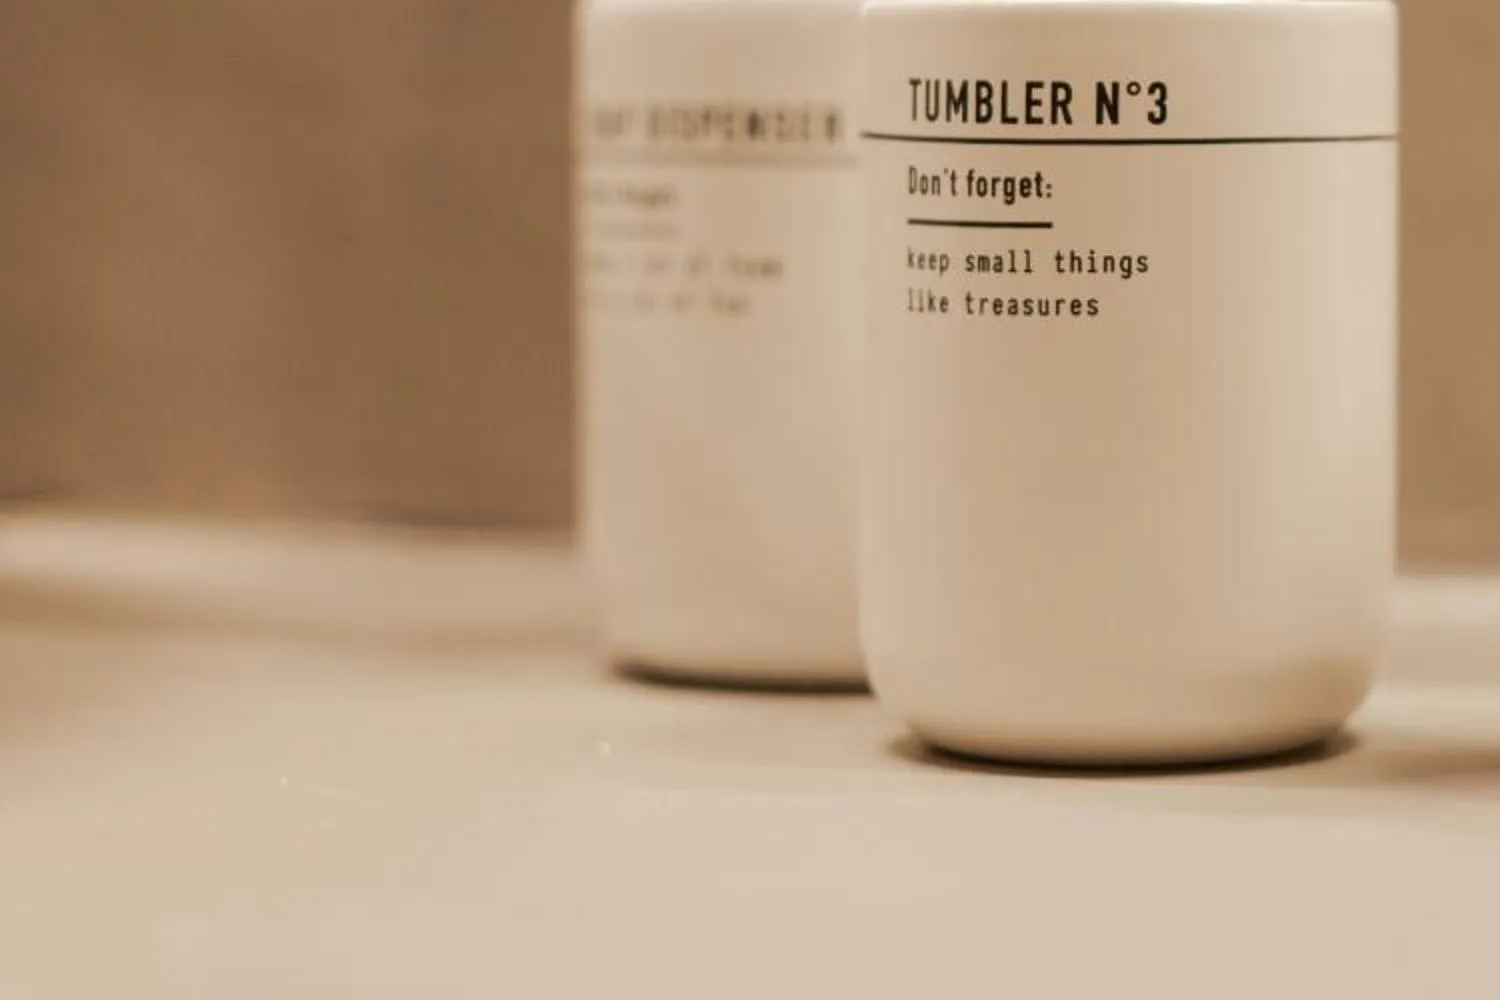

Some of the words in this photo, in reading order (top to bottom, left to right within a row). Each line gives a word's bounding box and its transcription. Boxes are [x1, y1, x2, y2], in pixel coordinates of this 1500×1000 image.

[908, 78, 1073, 126] TUMBLER
[1094, 80, 1169, 126] N°3
[908, 166, 959, 197] Don't
[966, 168, 1053, 206] forget:
[907, 248, 950, 276] keep
[964, 250, 1034, 274] small
[1054, 250, 1150, 280] things
[907, 288, 949, 313] like
[964, 292, 1100, 316] treasures
